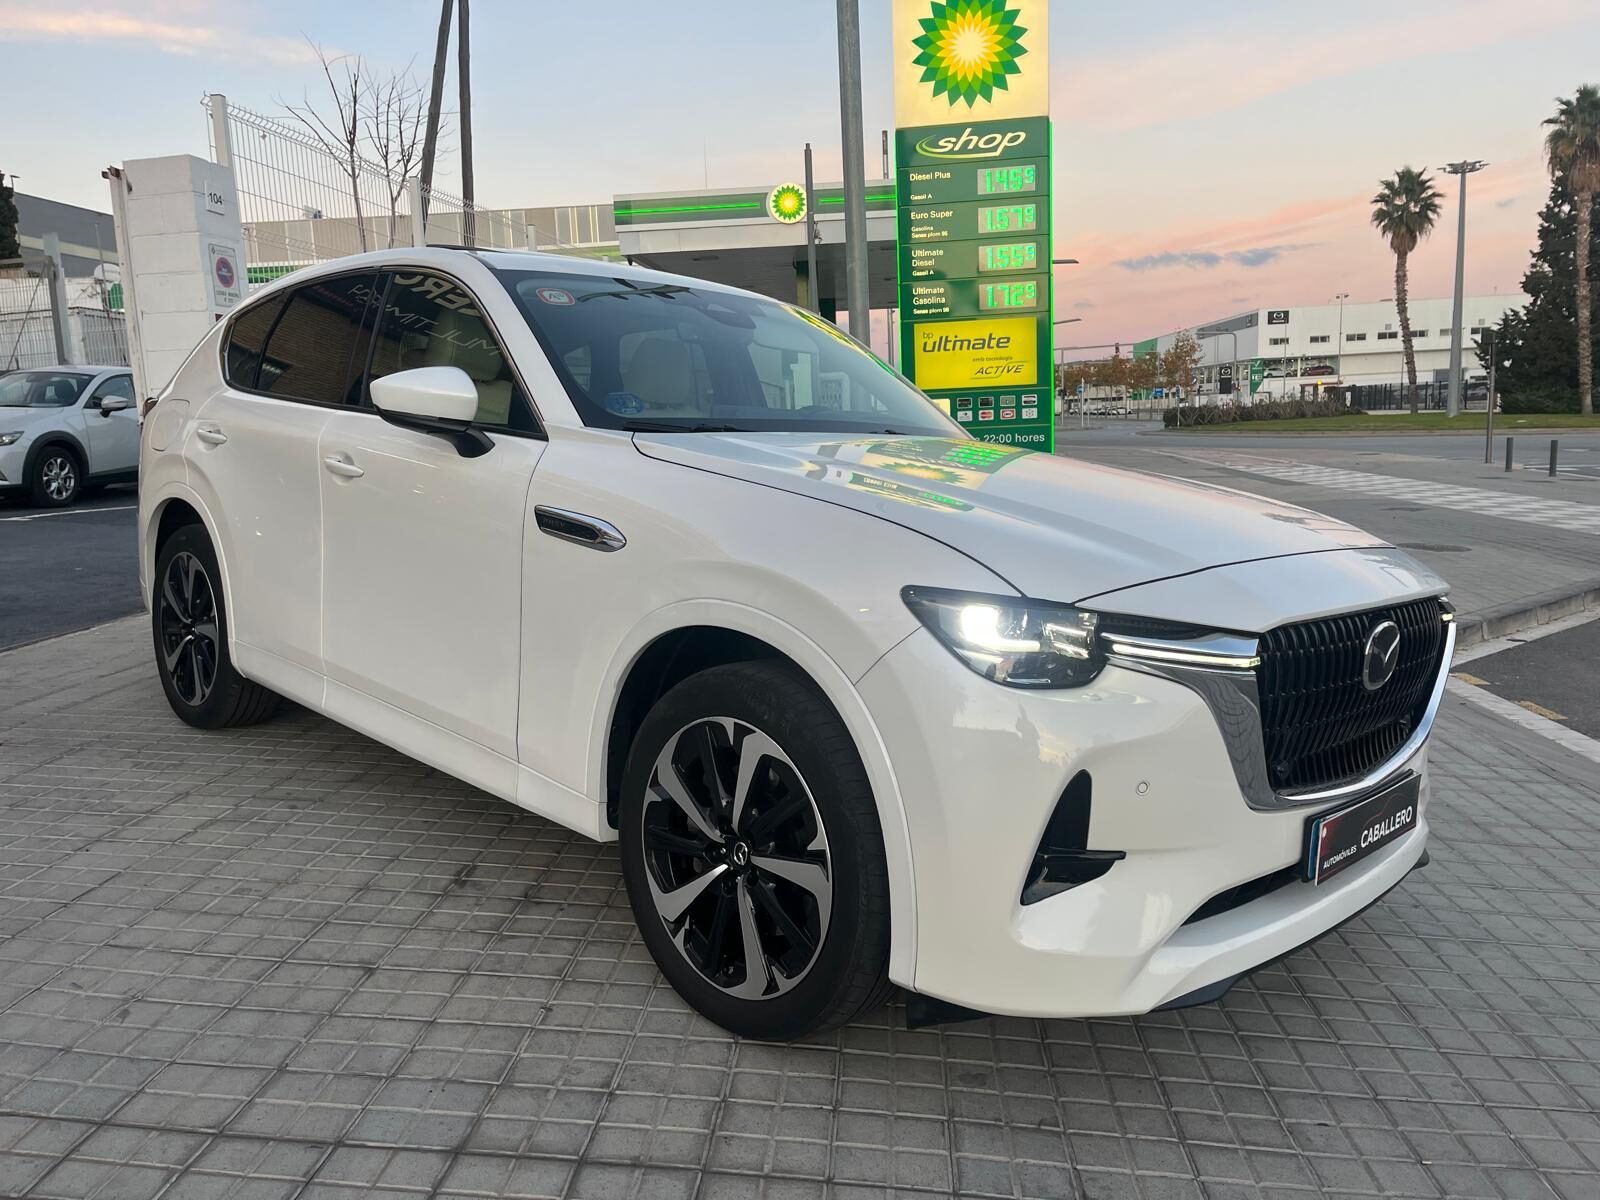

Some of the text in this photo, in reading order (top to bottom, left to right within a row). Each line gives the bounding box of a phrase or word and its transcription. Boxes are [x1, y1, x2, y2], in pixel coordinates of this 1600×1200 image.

[936, 128, 1026, 157] shop
[910, 171, 951, 181] Diesel Plus
[209, 192, 223, 205] 104
[911, 210, 953, 219] Euro Super
[986, 206, 1035, 232] 1.579
[911, 249, 944, 258] Ultimate
[912, 258, 935, 267] Diesel
[912, 287, 945, 296] Ultimate
[988, 283, 1036, 308] 1.729
[913, 297, 946, 306] Gasolina
[922, 332, 933, 340] bp
[923, 333, 1011, 353] ultimate
[975, 364, 1024, 375] ACTIVE
[983, 434, 1012, 443] 22:00
[1015, 432, 1045, 442] hores
[1323, 805, 1413, 869] AUTOMÓVILES CABALLERO
